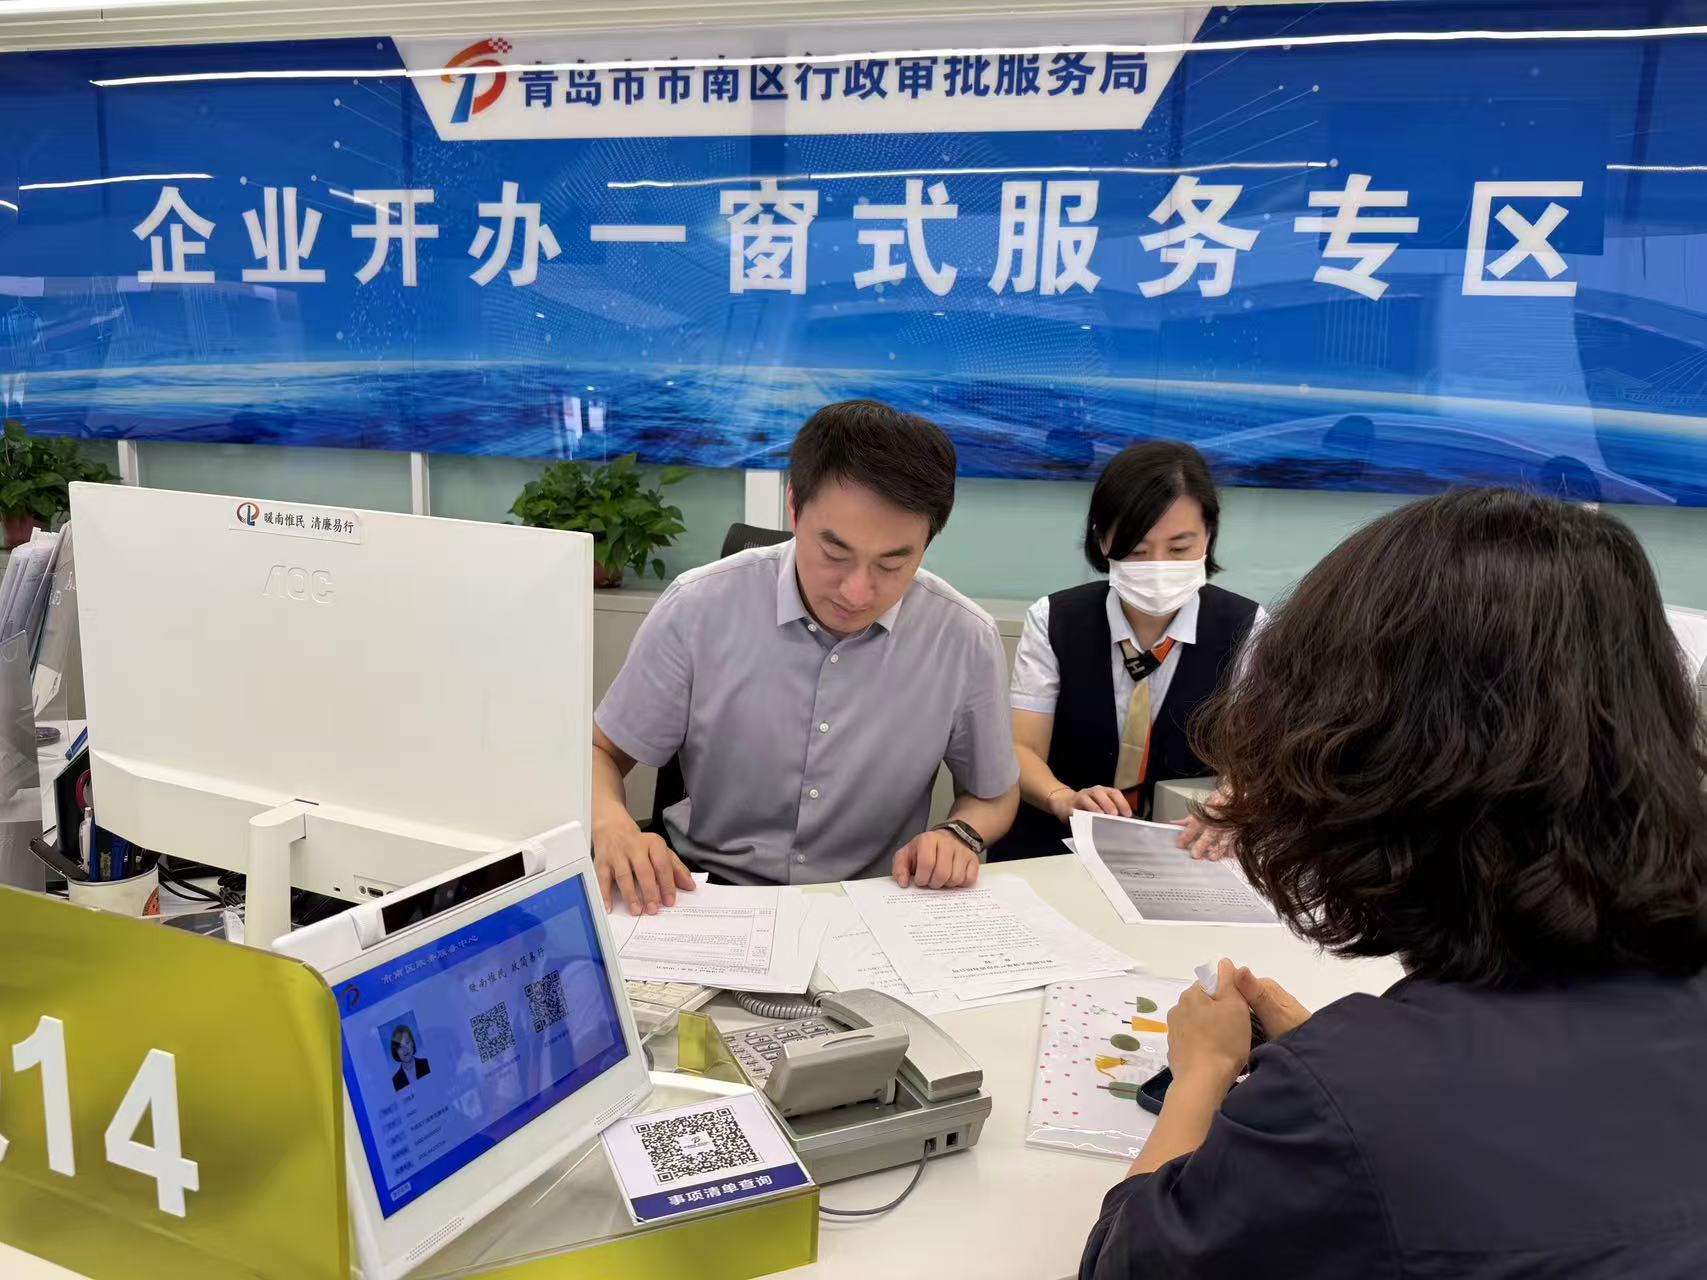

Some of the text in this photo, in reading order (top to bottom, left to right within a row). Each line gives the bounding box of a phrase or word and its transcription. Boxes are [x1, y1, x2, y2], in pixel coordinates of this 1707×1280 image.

[518, 47, 1148, 108] 青岛市市南区行政审批服务局
[132, 173, 1584, 301] 企业开办一窗式服务专区
[262, 563, 334, 604] AOC
[0, 1014, 199, 1218] 14
[666, 1174, 773, 1206] 事项清单查询
